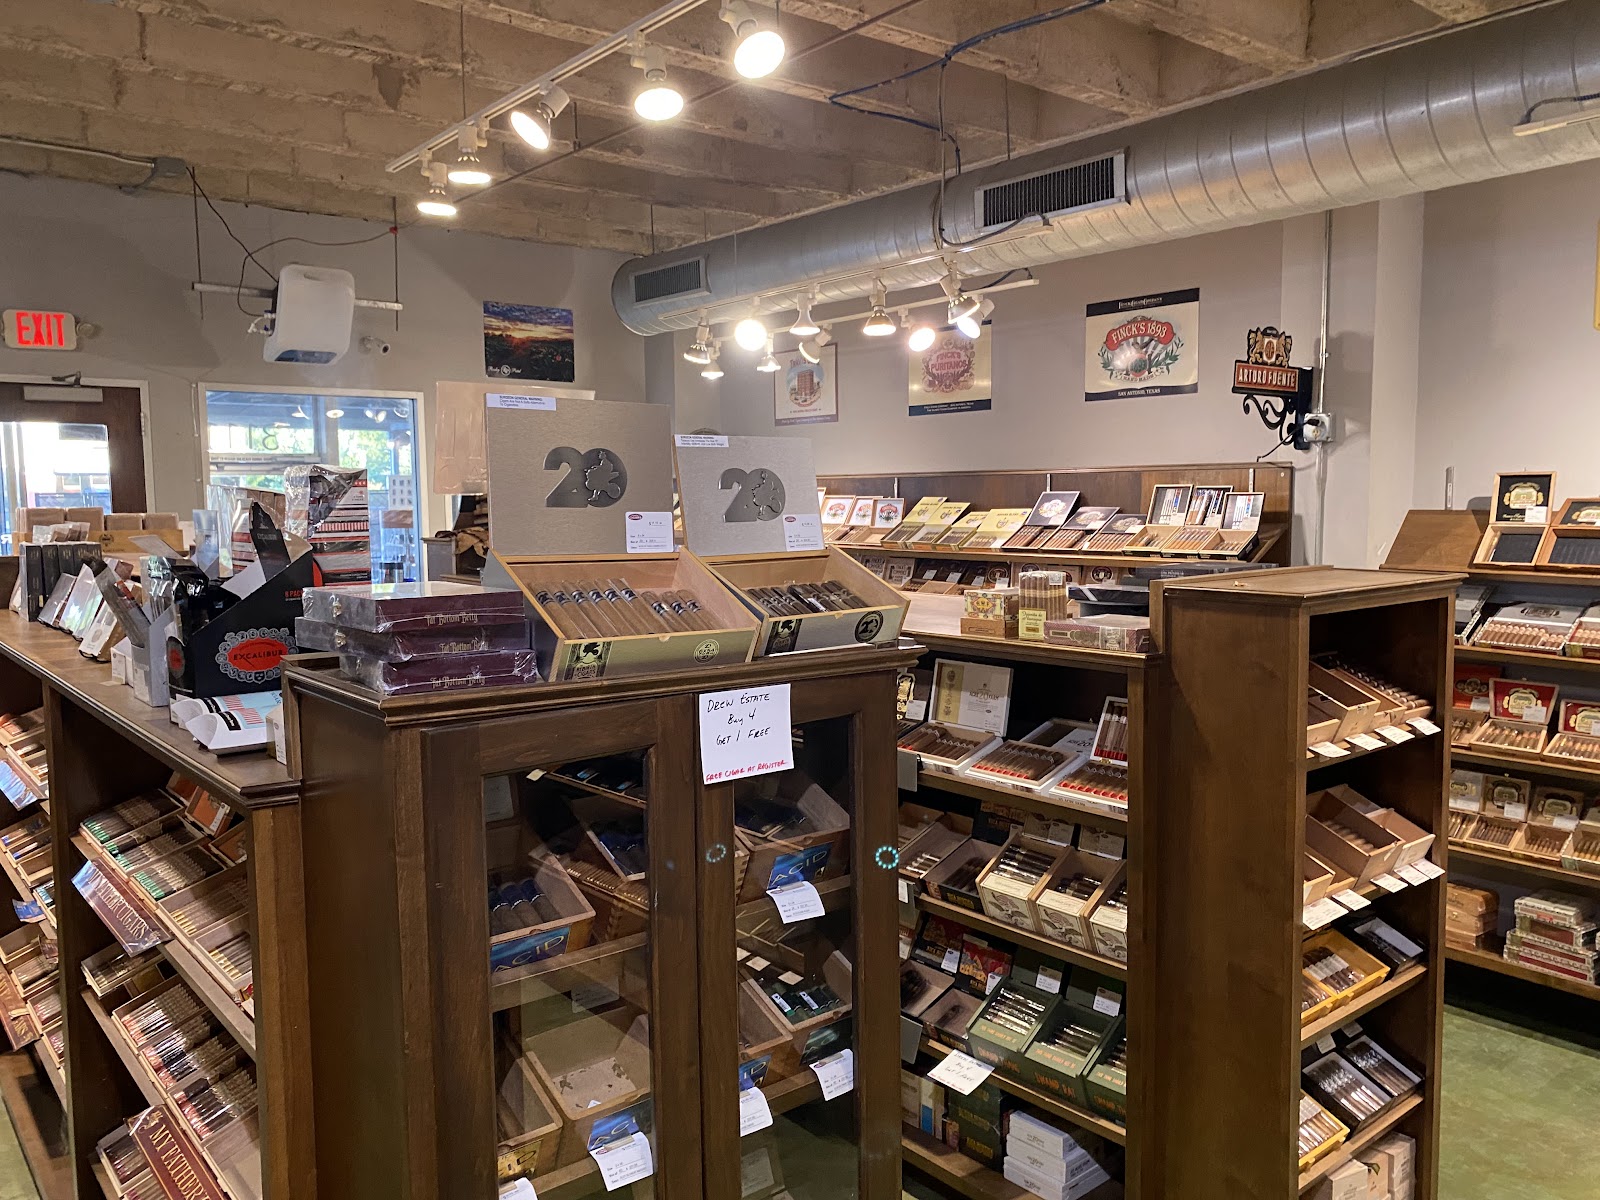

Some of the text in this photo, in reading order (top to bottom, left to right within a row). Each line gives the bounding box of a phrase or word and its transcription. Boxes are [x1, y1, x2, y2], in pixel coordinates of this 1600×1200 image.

[16, 312, 65, 347] EXIT
[1111, 320, 1167, 343] FINCK'S 1893
[930, 360, 968, 371] PURITANOS
[936, 351, 961, 361] FINCK'S
[1238, 368, 1296, 388] ARTURO FUENTE
[543, 446, 628, 508] 20
[718, 467, 786, 523] 20
[437, 614, 460, 626] Bottom
[233, 649, 284, 661] EXCALIBUR
[707, 693, 770, 713] DREW ESTATE
[728, 707, 757, 725] Buy 4
[748, 726, 771, 739] FREE
[747, 765, 756, 773] AT
[771, 850, 828, 886] ACID
[97, 879, 126, 914] FATHER
[116, 905, 149, 940] CIGARS
[149, 1124, 205, 1200] MY FATHER
